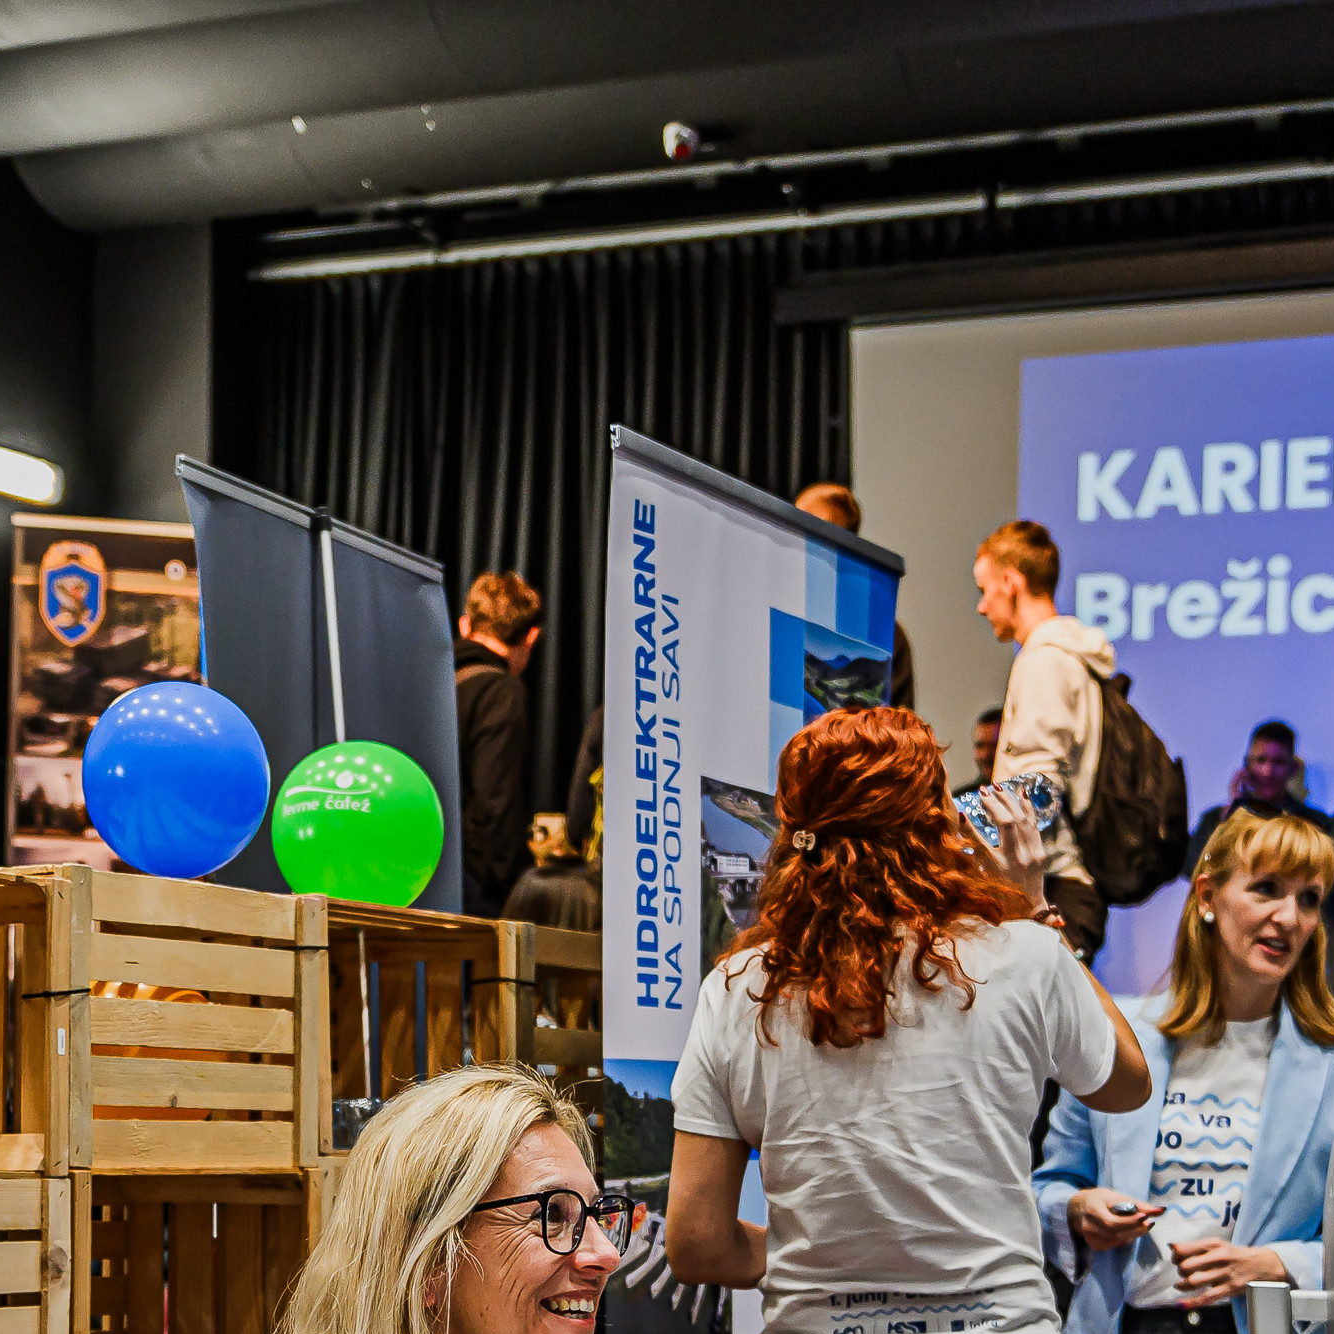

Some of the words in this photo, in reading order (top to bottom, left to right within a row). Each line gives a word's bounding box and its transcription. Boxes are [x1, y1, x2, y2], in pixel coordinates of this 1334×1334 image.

[661, 593, 680, 702] SAVI
[634, 499, 659, 1008] HIDROELEKTRARNE
[662, 717, 682, 926] SPODNJI
[664, 942, 683, 1010] NA
[1199, 1113, 1232, 1128] va
[1180, 1178, 1214, 1196] zu
